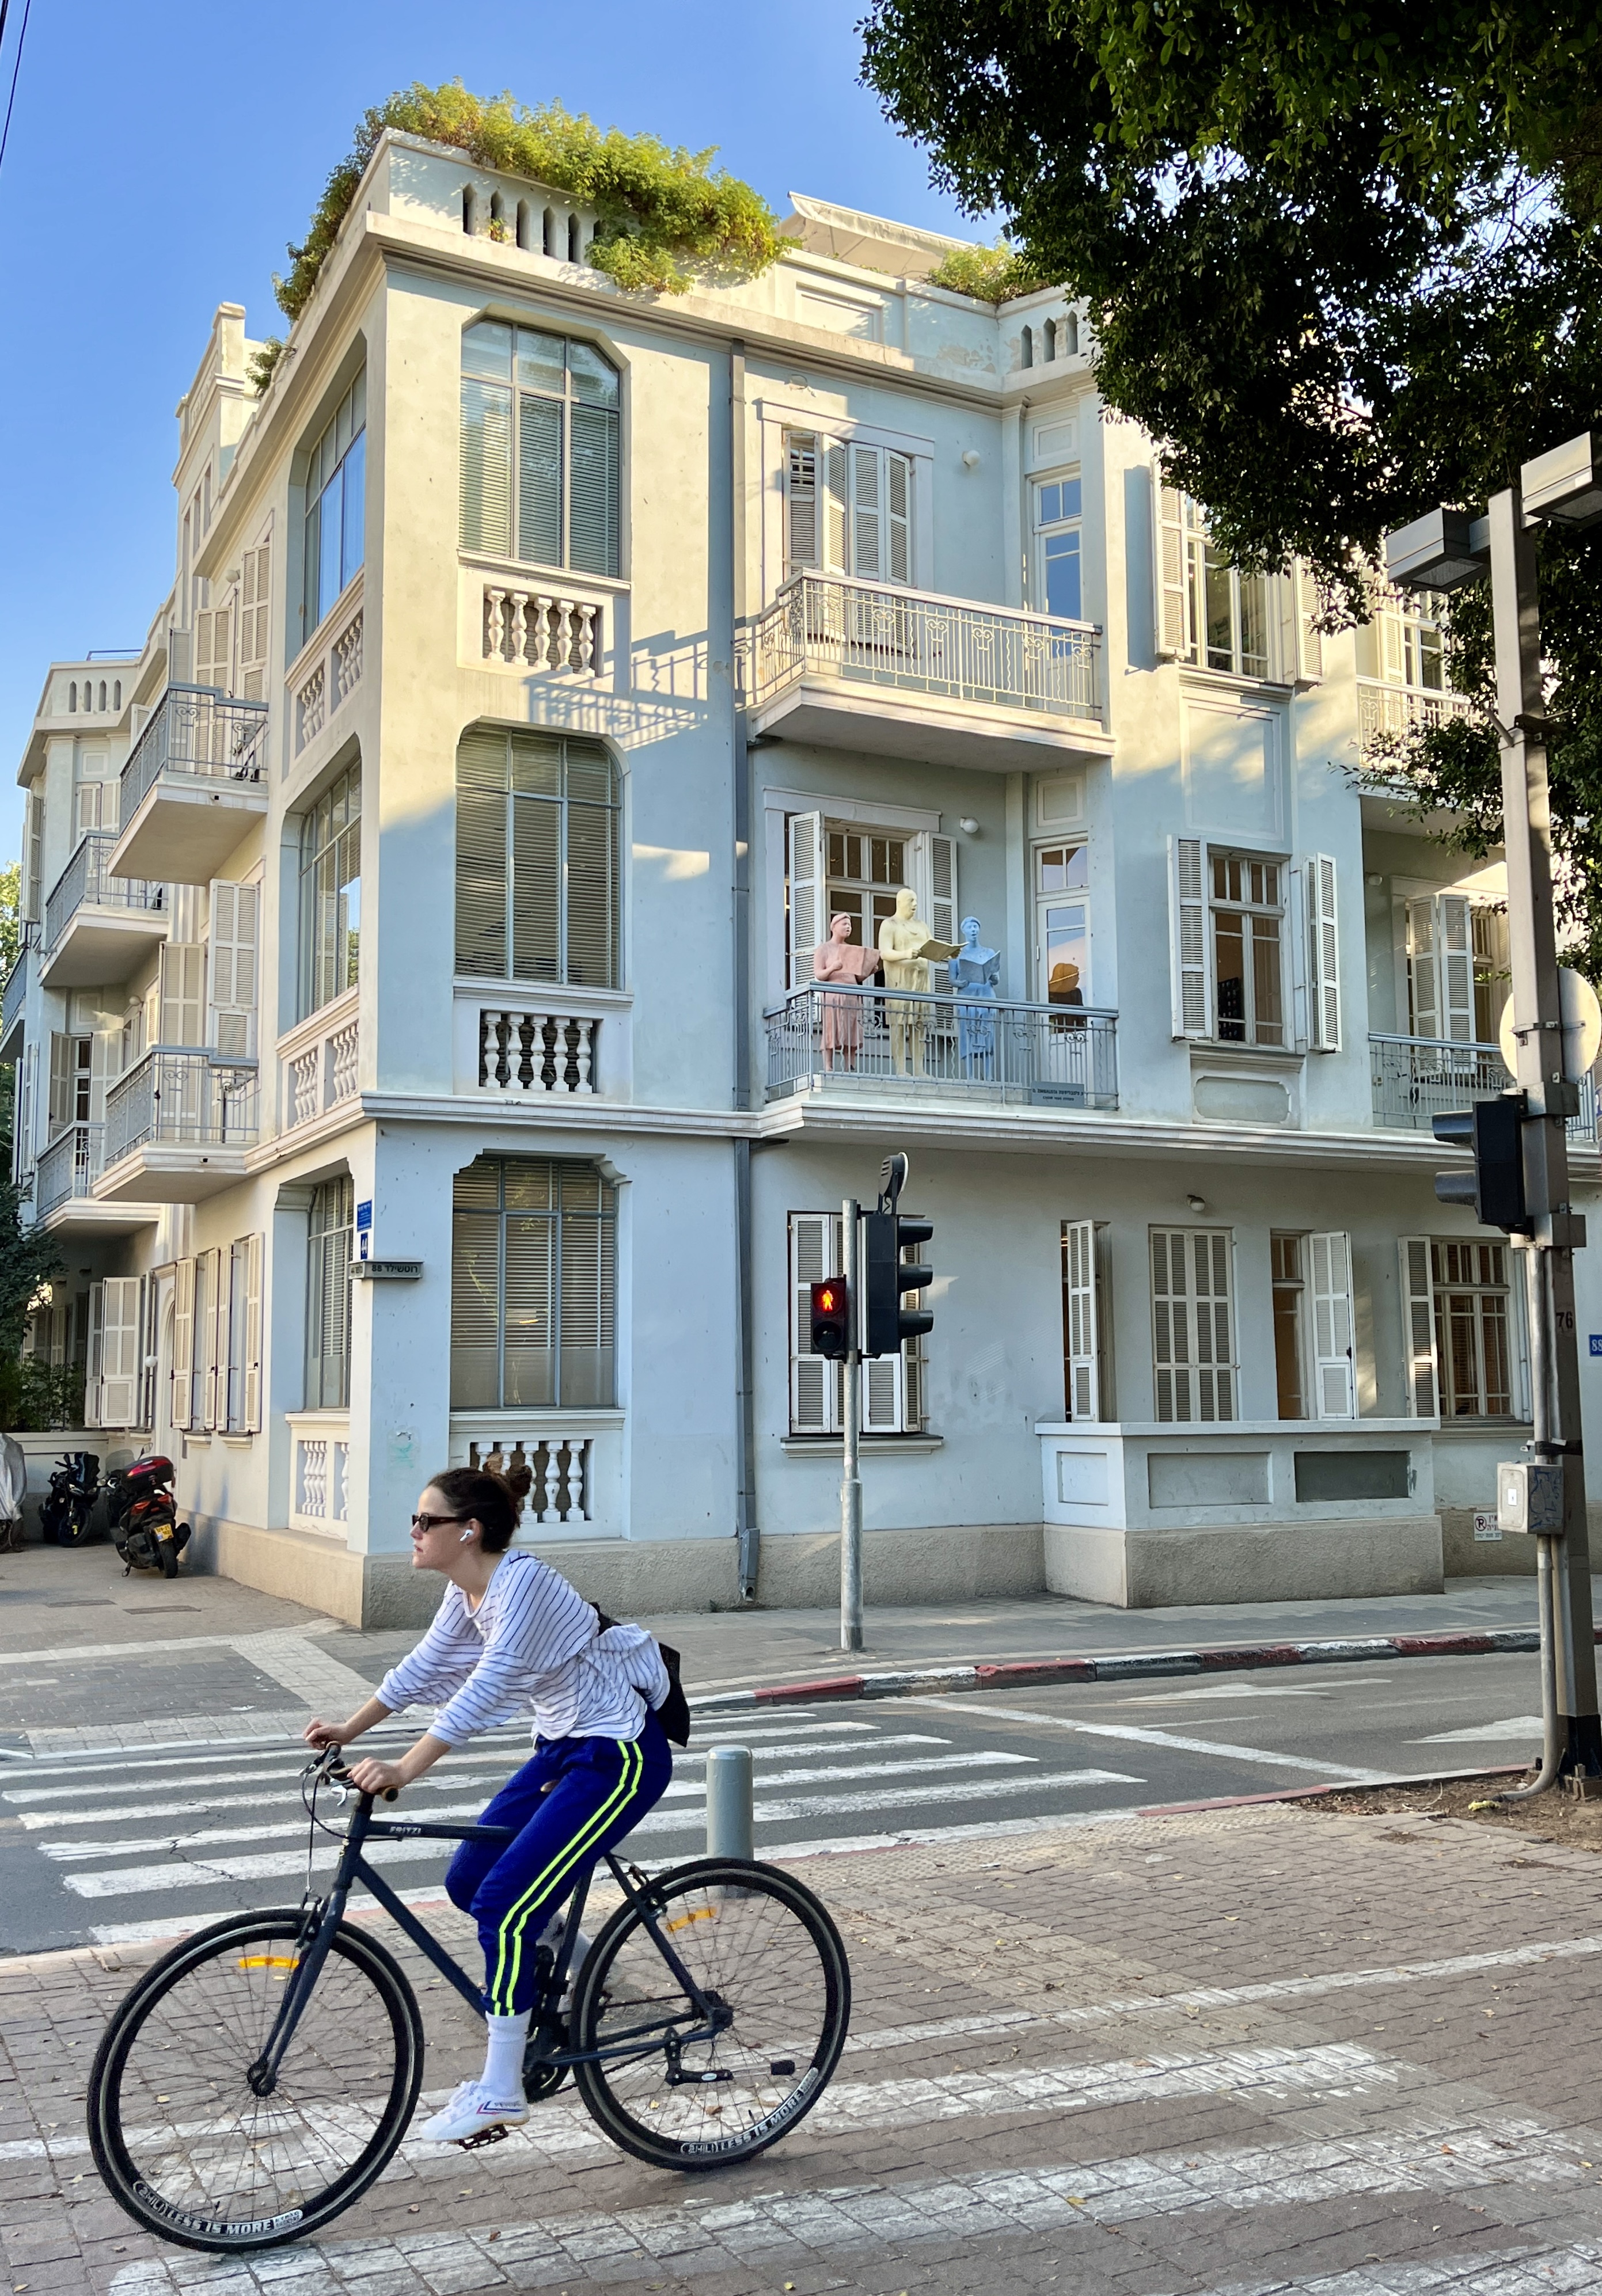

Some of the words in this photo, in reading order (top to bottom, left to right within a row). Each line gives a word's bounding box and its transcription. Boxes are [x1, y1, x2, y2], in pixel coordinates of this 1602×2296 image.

[362, 1238, 367, 1255] 44
[385, 1264, 418, 1273] רוטשילד
[1556, 1311, 1573, 1329] 76
[1592, 1339, 1602, 1352] 88
[721, 2133, 752, 2151] LESS
[754, 2123, 768, 2137] IS
[770, 2090, 804, 2126] MORE
[167, 2210, 202, 2230] LESS
[206, 2221, 221, 2233] IS
[227, 2219, 274, 2235] MORE
